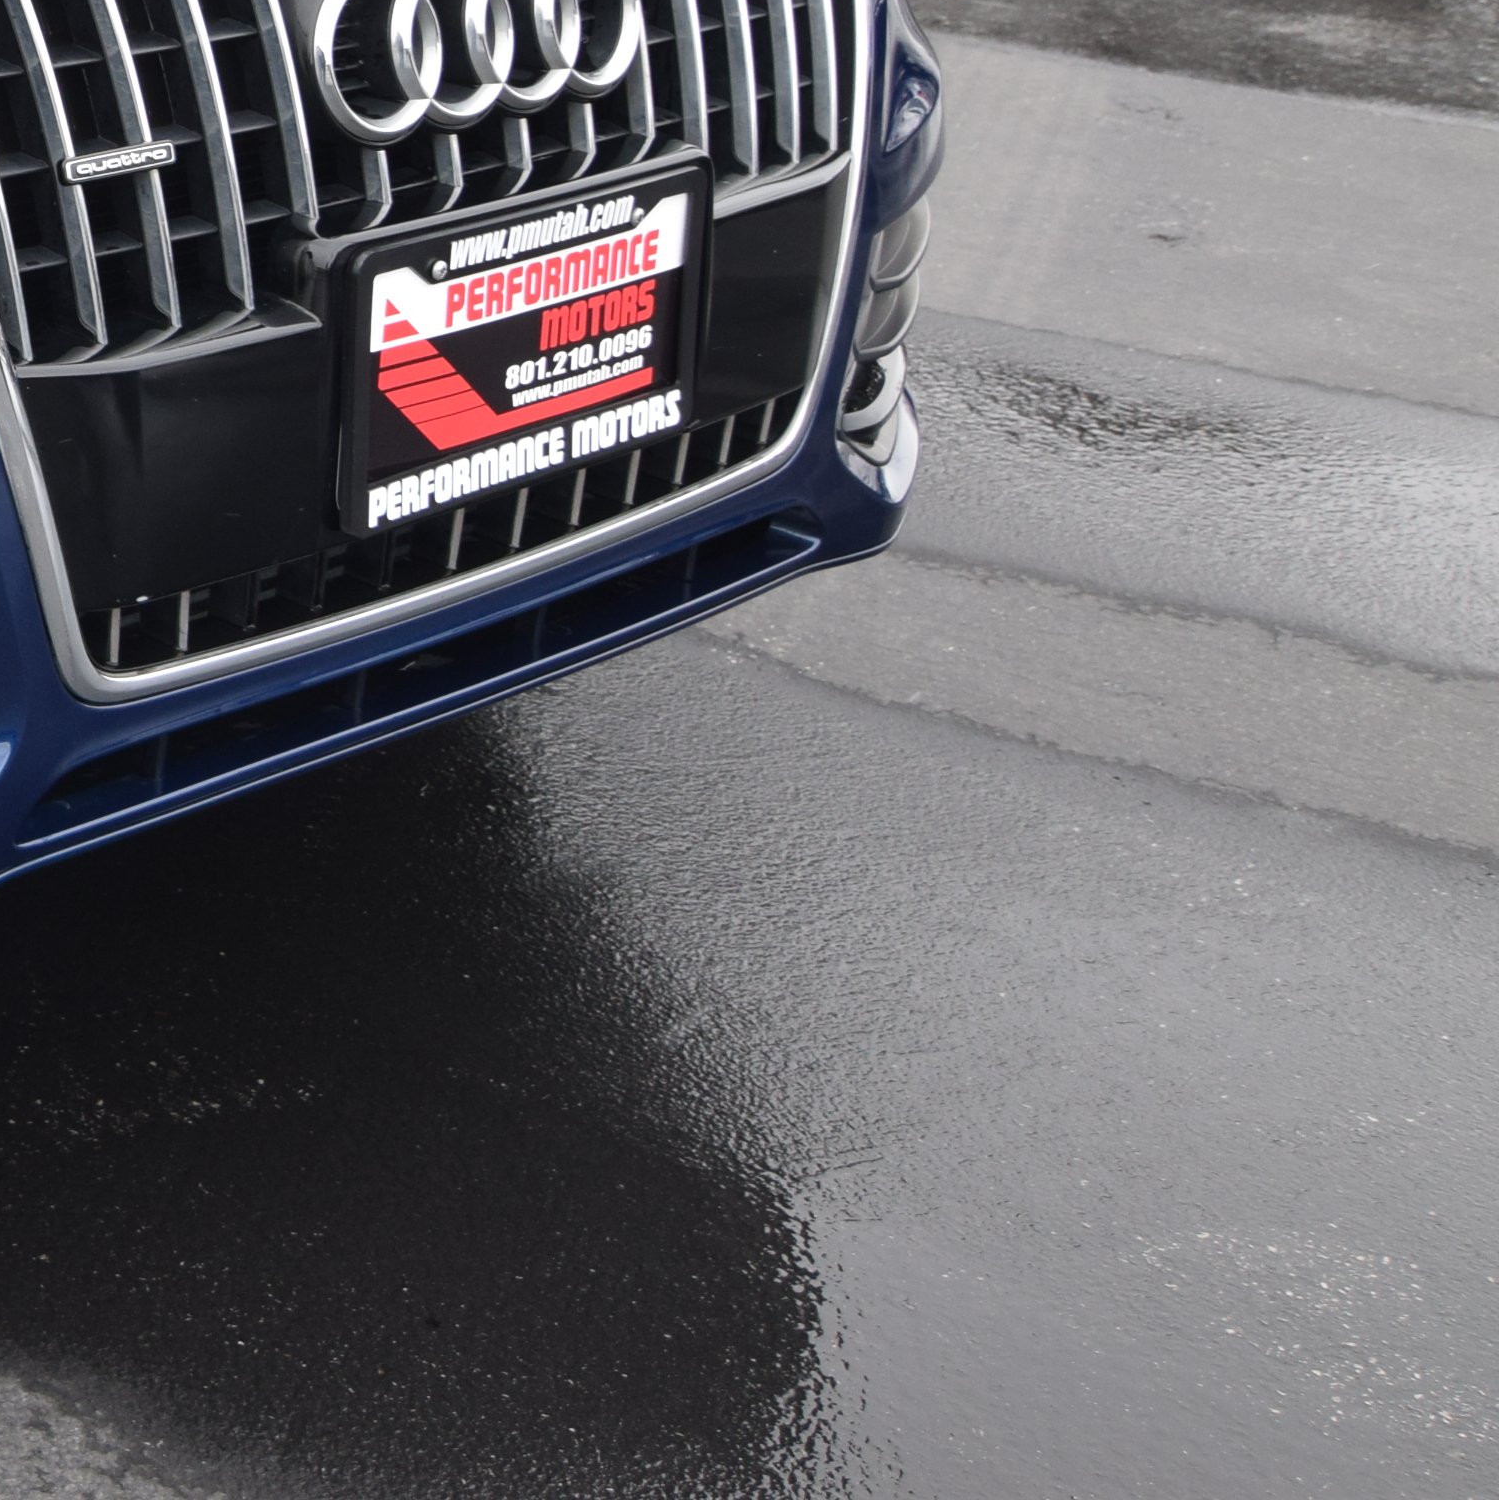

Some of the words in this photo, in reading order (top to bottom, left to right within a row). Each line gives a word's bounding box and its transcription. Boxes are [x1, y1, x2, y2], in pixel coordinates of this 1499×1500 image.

[76, 148, 168, 176] quattro
[449, 194, 634, 270] www.pmutah.com
[444, 229, 659, 328] PERFORMANCE
[539, 279, 657, 352] MOTORS
[504, 324, 653, 391] 801.210.0096
[511, 354, 644, 408] www.pmutah.com
[367, 426, 565, 529] PERFORMANCE
[571, 389, 683, 459] MOTORS
